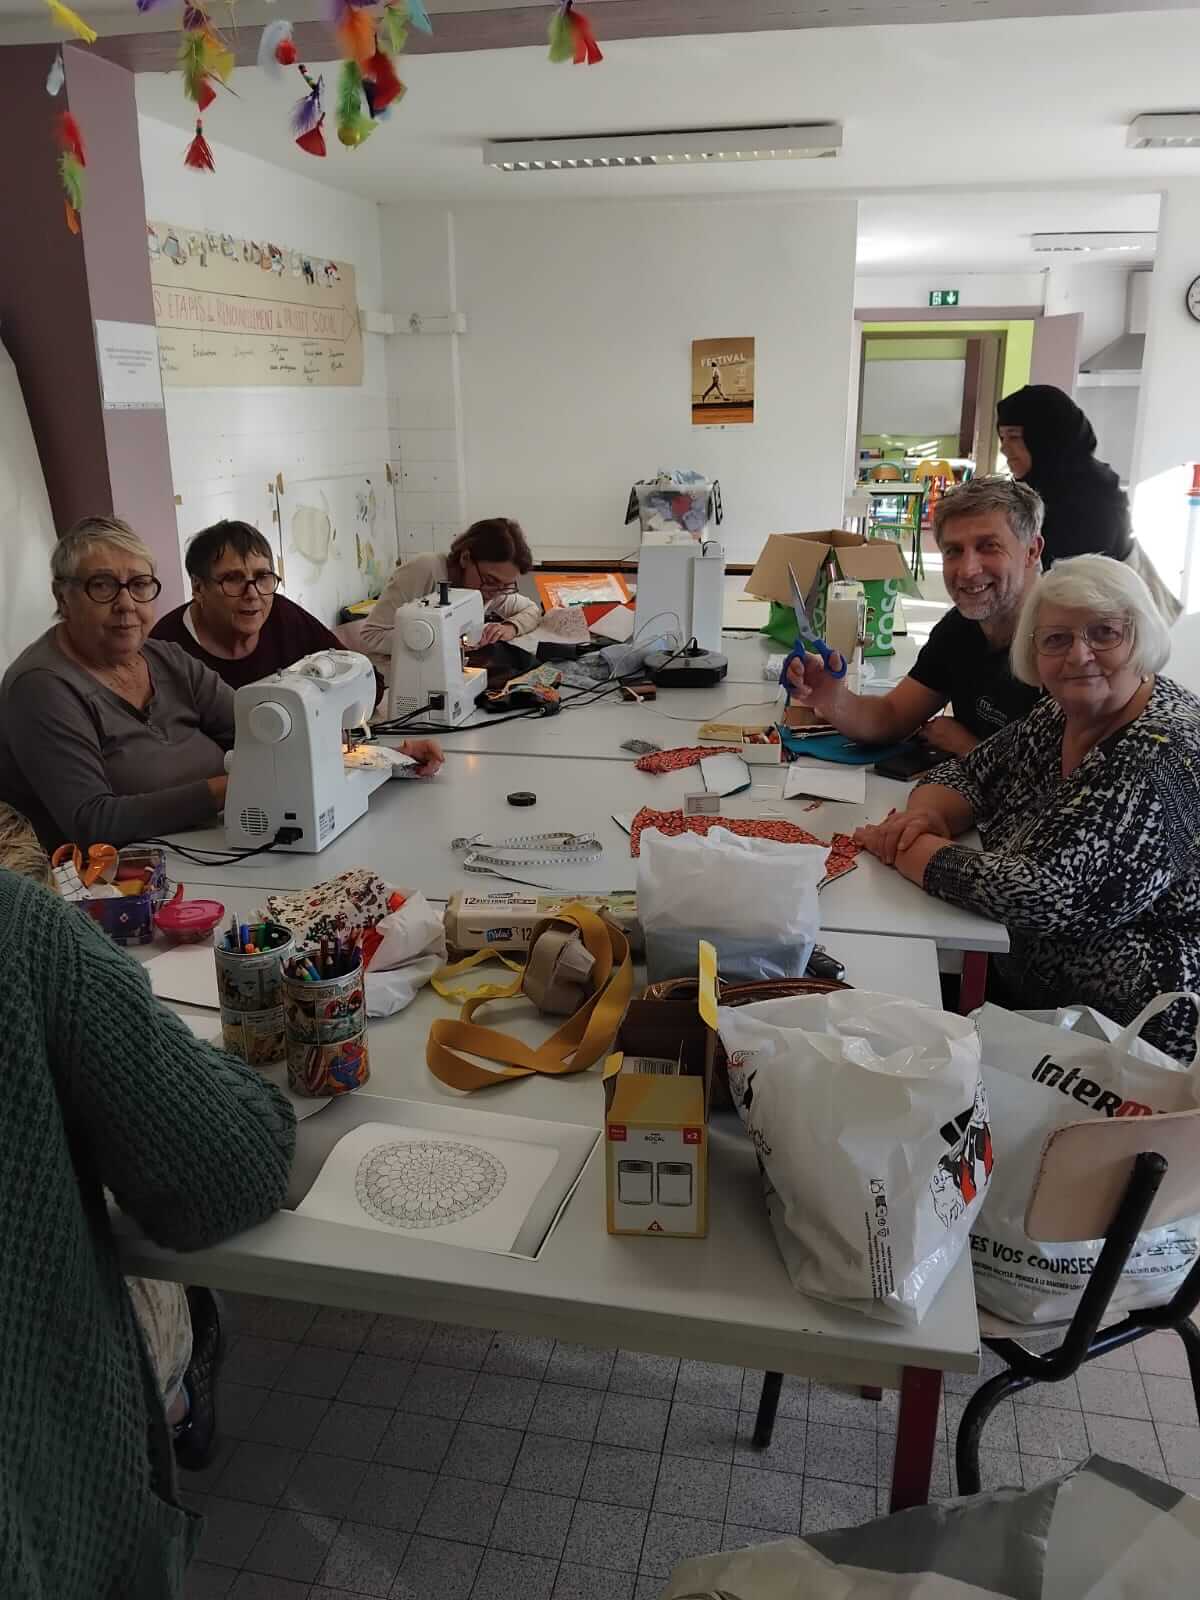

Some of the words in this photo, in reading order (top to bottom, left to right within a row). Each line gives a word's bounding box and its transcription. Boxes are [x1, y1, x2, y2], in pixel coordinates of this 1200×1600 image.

[521, 927, 533, 941] 12
[968, 1233, 989, 1252] ES
[992, 1241, 1024, 1263] VOS
[1027, 1255, 1096, 1275] COURSES
